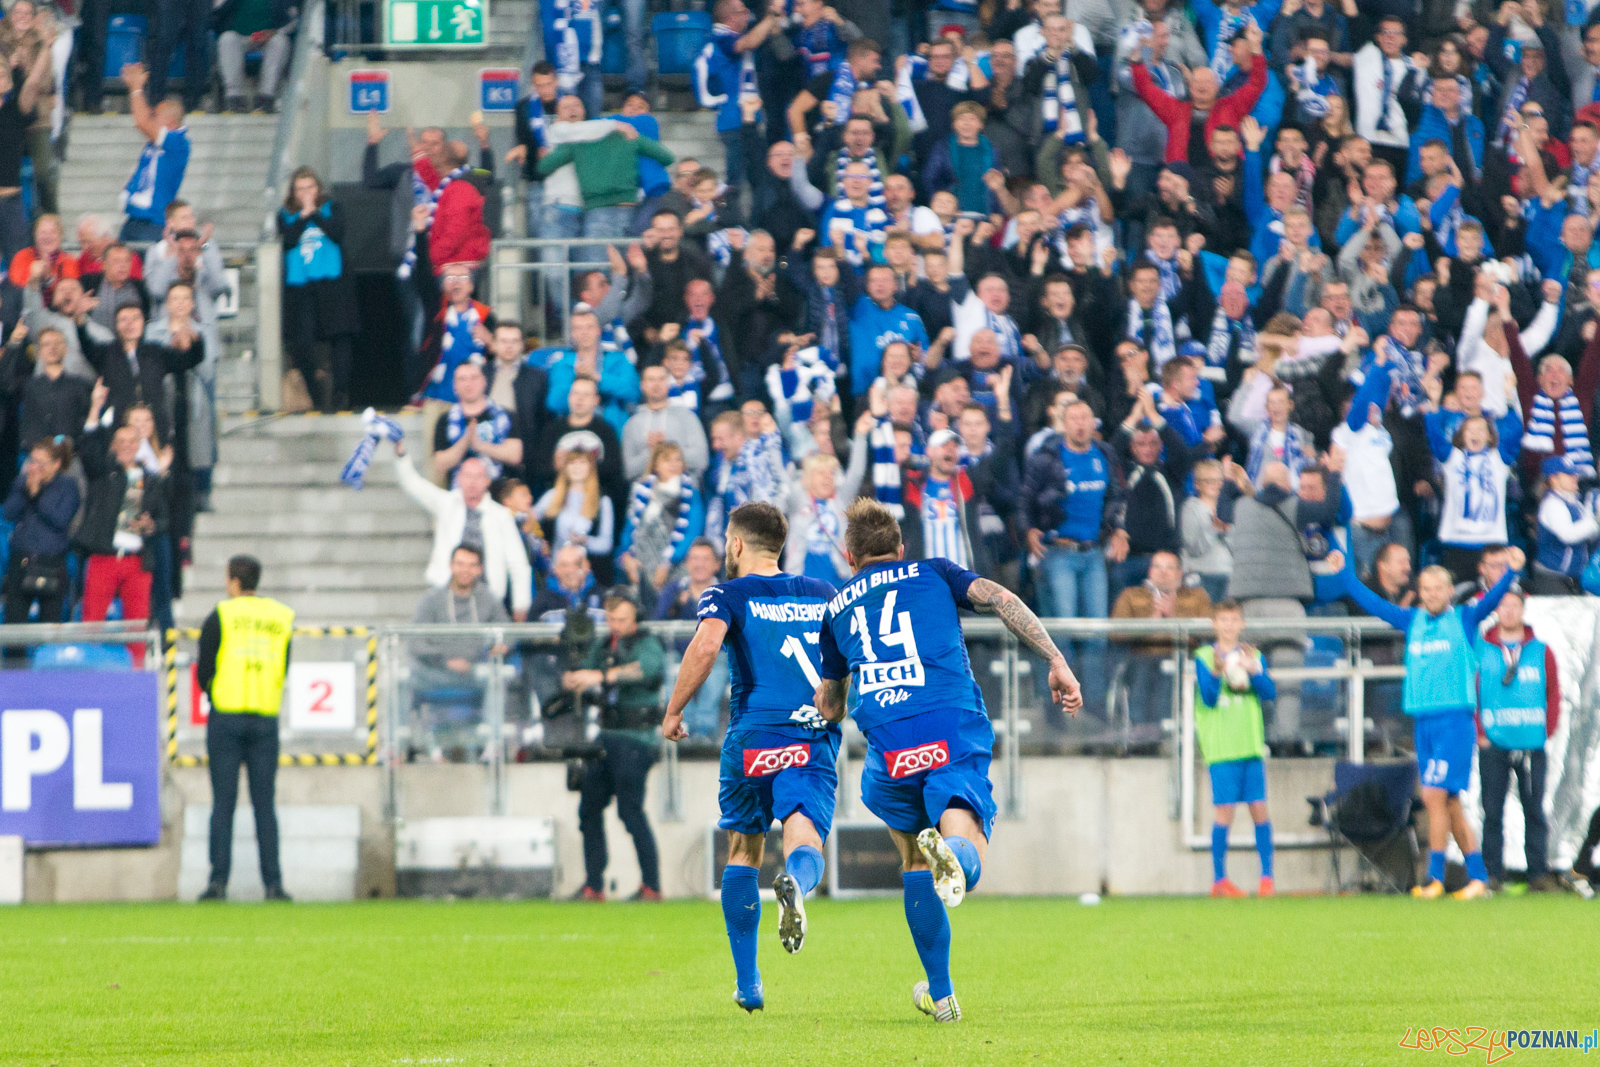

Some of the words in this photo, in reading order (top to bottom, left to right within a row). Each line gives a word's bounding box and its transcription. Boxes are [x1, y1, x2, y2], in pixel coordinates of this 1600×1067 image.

[828, 577, 868, 618] NICKI
[870, 562, 920, 588] BILLE
[849, 589, 919, 663] 14
[309, 679, 334, 713] 2
[862, 663, 917, 686] LECH
[874, 687, 913, 708] Pils
[1, 708, 134, 812] PL
